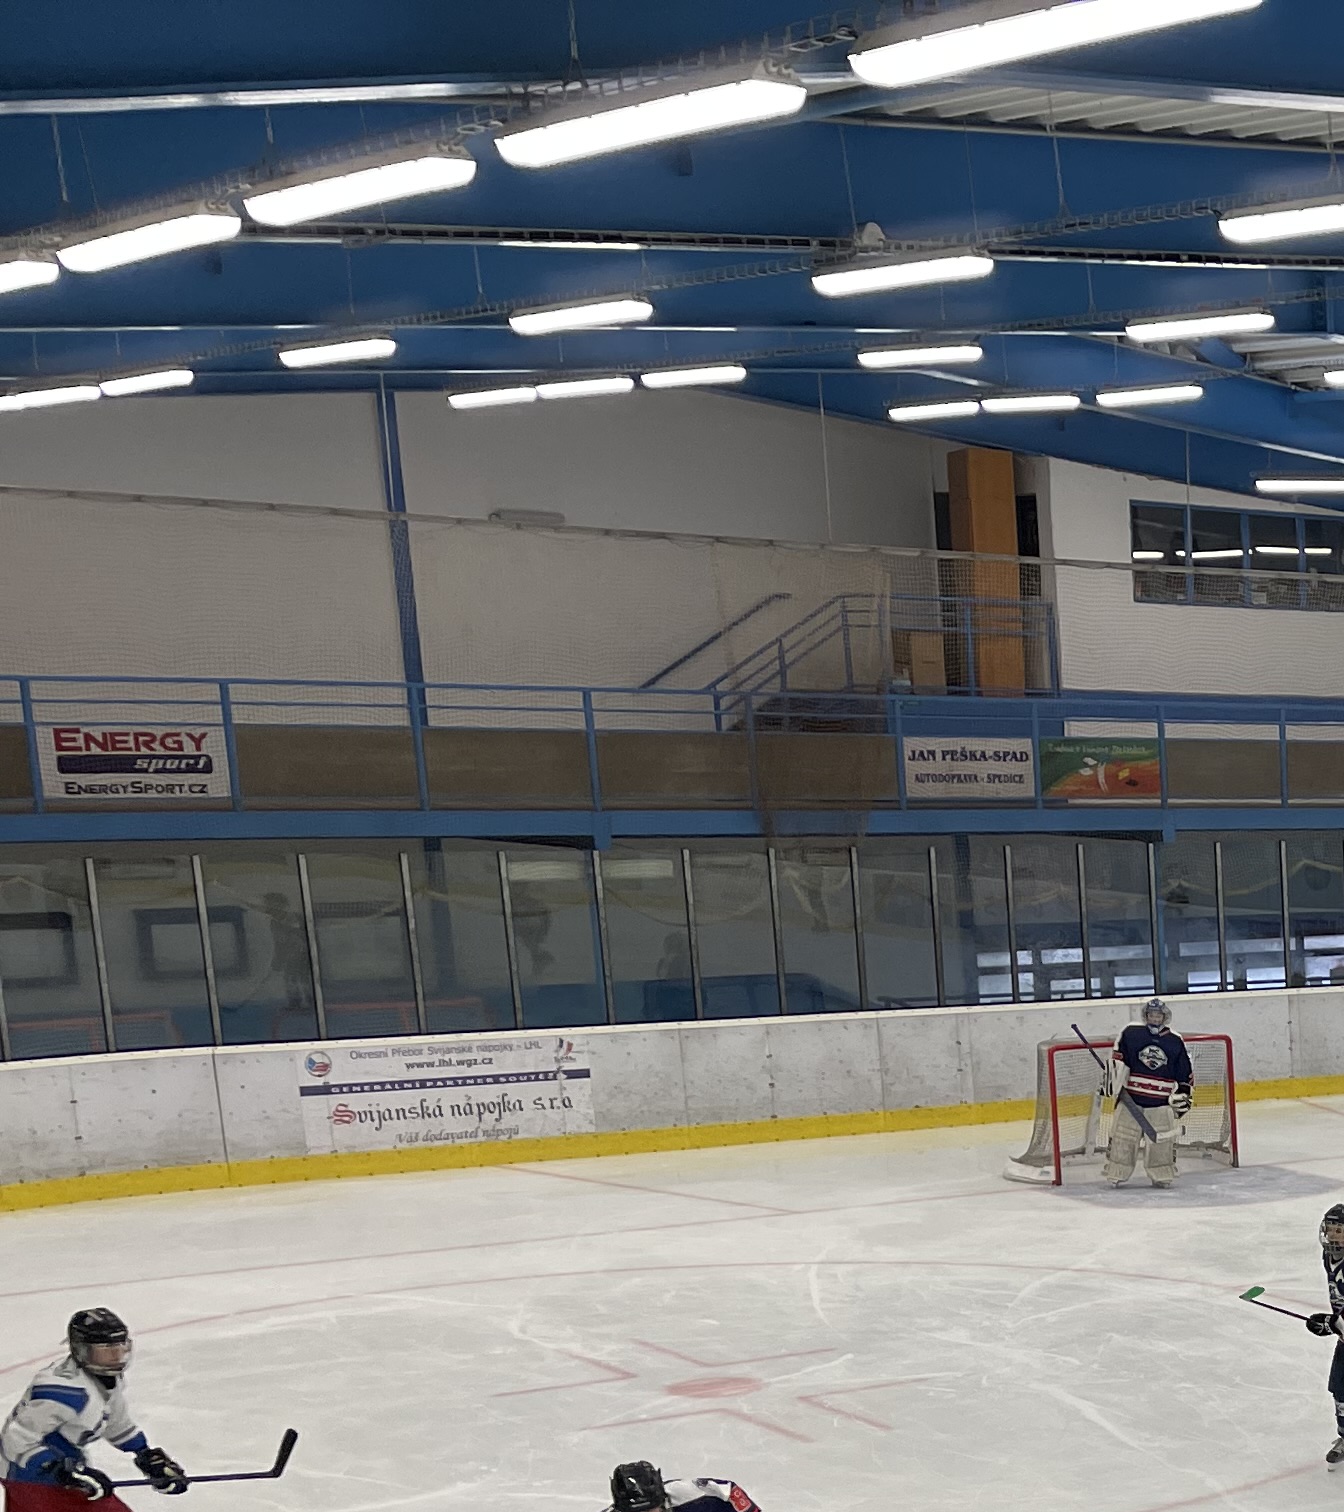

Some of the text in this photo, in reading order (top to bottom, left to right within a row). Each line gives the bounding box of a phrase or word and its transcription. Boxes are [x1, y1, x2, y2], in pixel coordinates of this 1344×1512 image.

[52, 727, 208, 752] ENERGY
[908, 749, 937, 763] JAN
[134, 757, 208, 773] sport
[914, 773, 979, 784] AUTODOPRAVA
[986, 773, 1025, 785] SPEDICE
[350, 1047, 388, 1060] Okresní
[392, 1046, 424, 1057] Přebor
[331, 1081, 420, 1093] GENERÁLNÍ
[426, 1077, 494, 1087] PARTNER
[333, 1098, 444, 1131] Svijanská
[450, 1093, 523, 1122] nápojka
[396, 1131, 419, 1143] Váš
[422, 1126, 480, 1142] dodavatel
